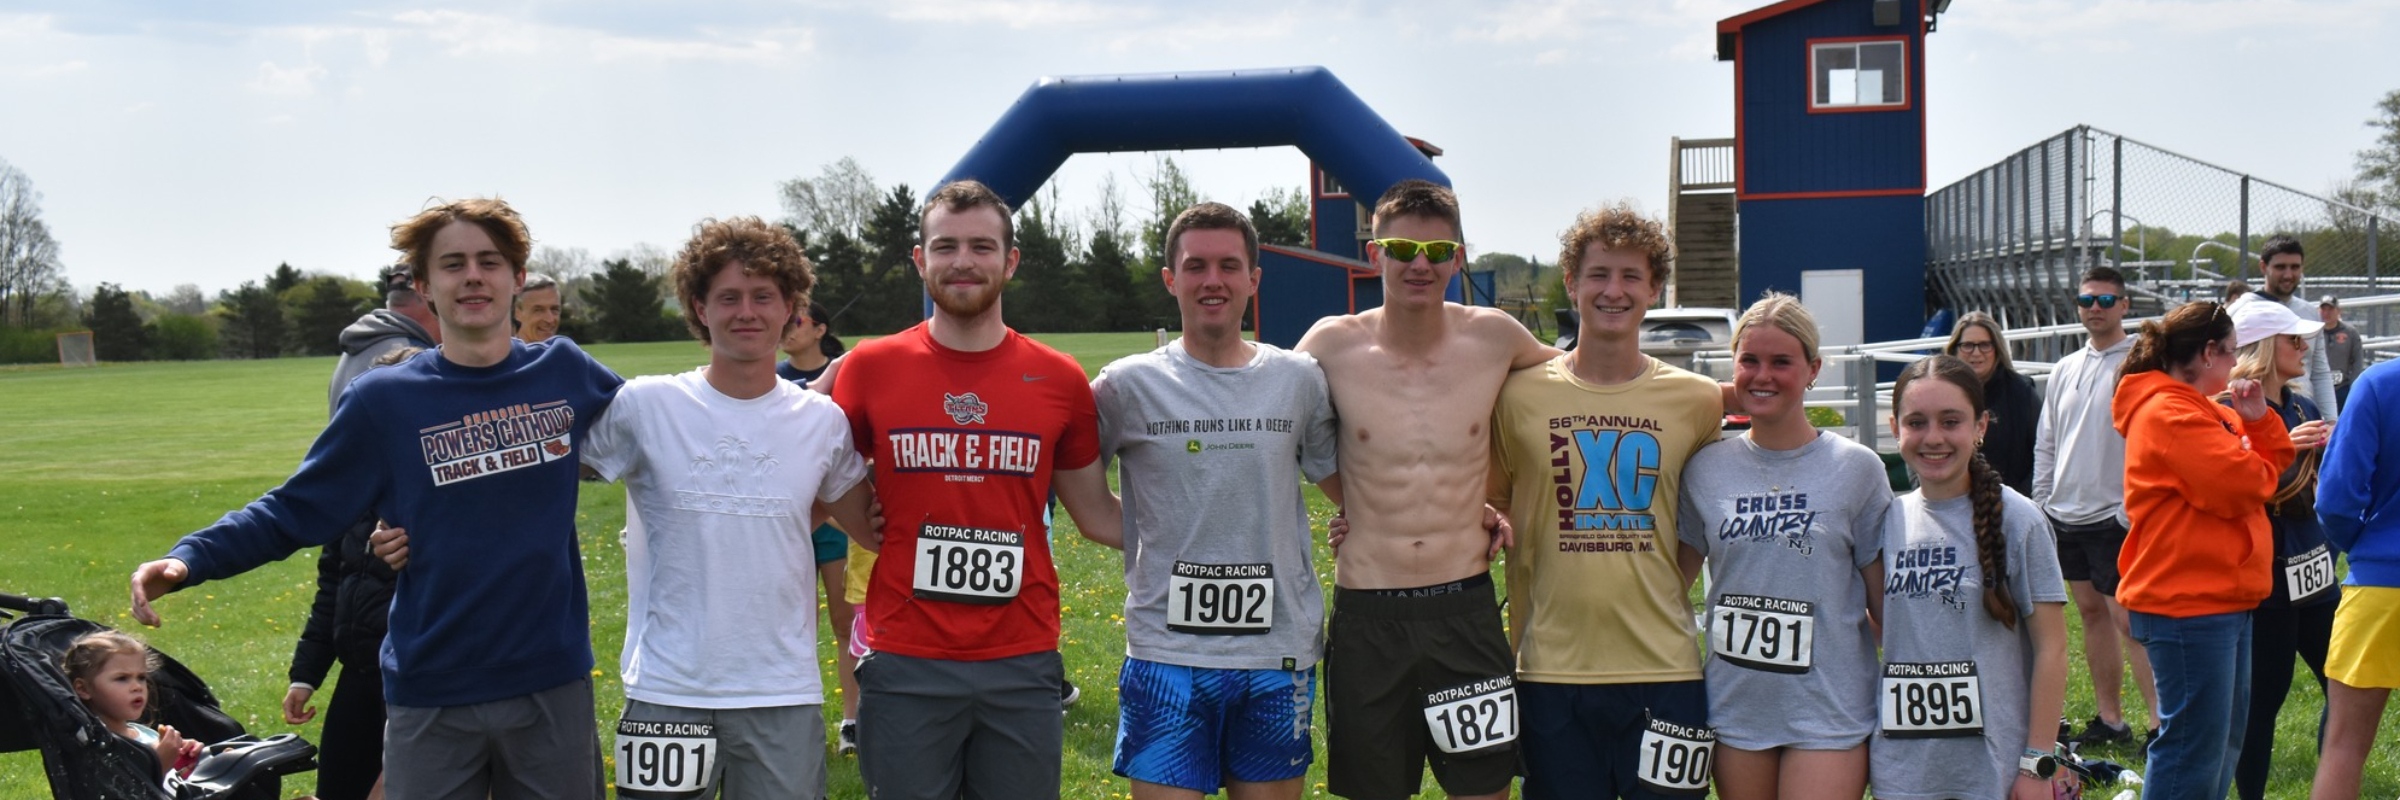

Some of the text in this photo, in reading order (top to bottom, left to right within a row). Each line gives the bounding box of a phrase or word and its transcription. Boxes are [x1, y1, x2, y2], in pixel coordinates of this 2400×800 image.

[421, 405, 574, 465] POWERS CATHOLIC
[1146, 420, 1190, 435] NOTHING
[1193, 420, 1224, 432] RUNS
[1228, 419, 1252, 432] LIKE
[1255, 419, 1263, 431] A
[1549, 415, 1662, 431] 56TH ANNUAL
[434, 446, 538, 483] TRACK & FIELD
[889, 433, 1041, 473] TRACK & FIELD
[967, 475, 985, 483] MERCY
[1550, 432, 1574, 531] HOLLY
[1571, 429, 1661, 512] XC
[1736, 494, 1807, 514] CROSS
[925, 525, 1018, 543] ROTPAC RACING
[1574, 513, 1656, 530] INVITE
[1720, 511, 1815, 540] COUNTRY
[1559, 542, 1636, 553] DAVISBURG,
[1896, 547, 1956, 569] CROSS
[927, 545, 1015, 593] 1883
[1177, 563, 1267, 576] ROTPAC RACING
[1885, 566, 1965, 595] COUNTRY
[2293, 556, 2329, 595] 1857
[1179, 583, 1266, 623] 1902
[1724, 596, 1808, 613] ROTPAC RACING
[1723, 612, 1801, 661] 1791
[1888, 663, 1969, 675] ROTPAC RACING
[1428, 675, 1512, 704] ROTPAC RACING
[1890, 682, 1973, 726] 1895
[622, 722, 709, 736] ROTPAC RACING
[1436, 693, 1514, 749] 1827
[1650, 719, 1717, 740] ROTPAC RAC
[622, 741, 705, 787] 1901
[1650, 739, 1710, 785] 190
